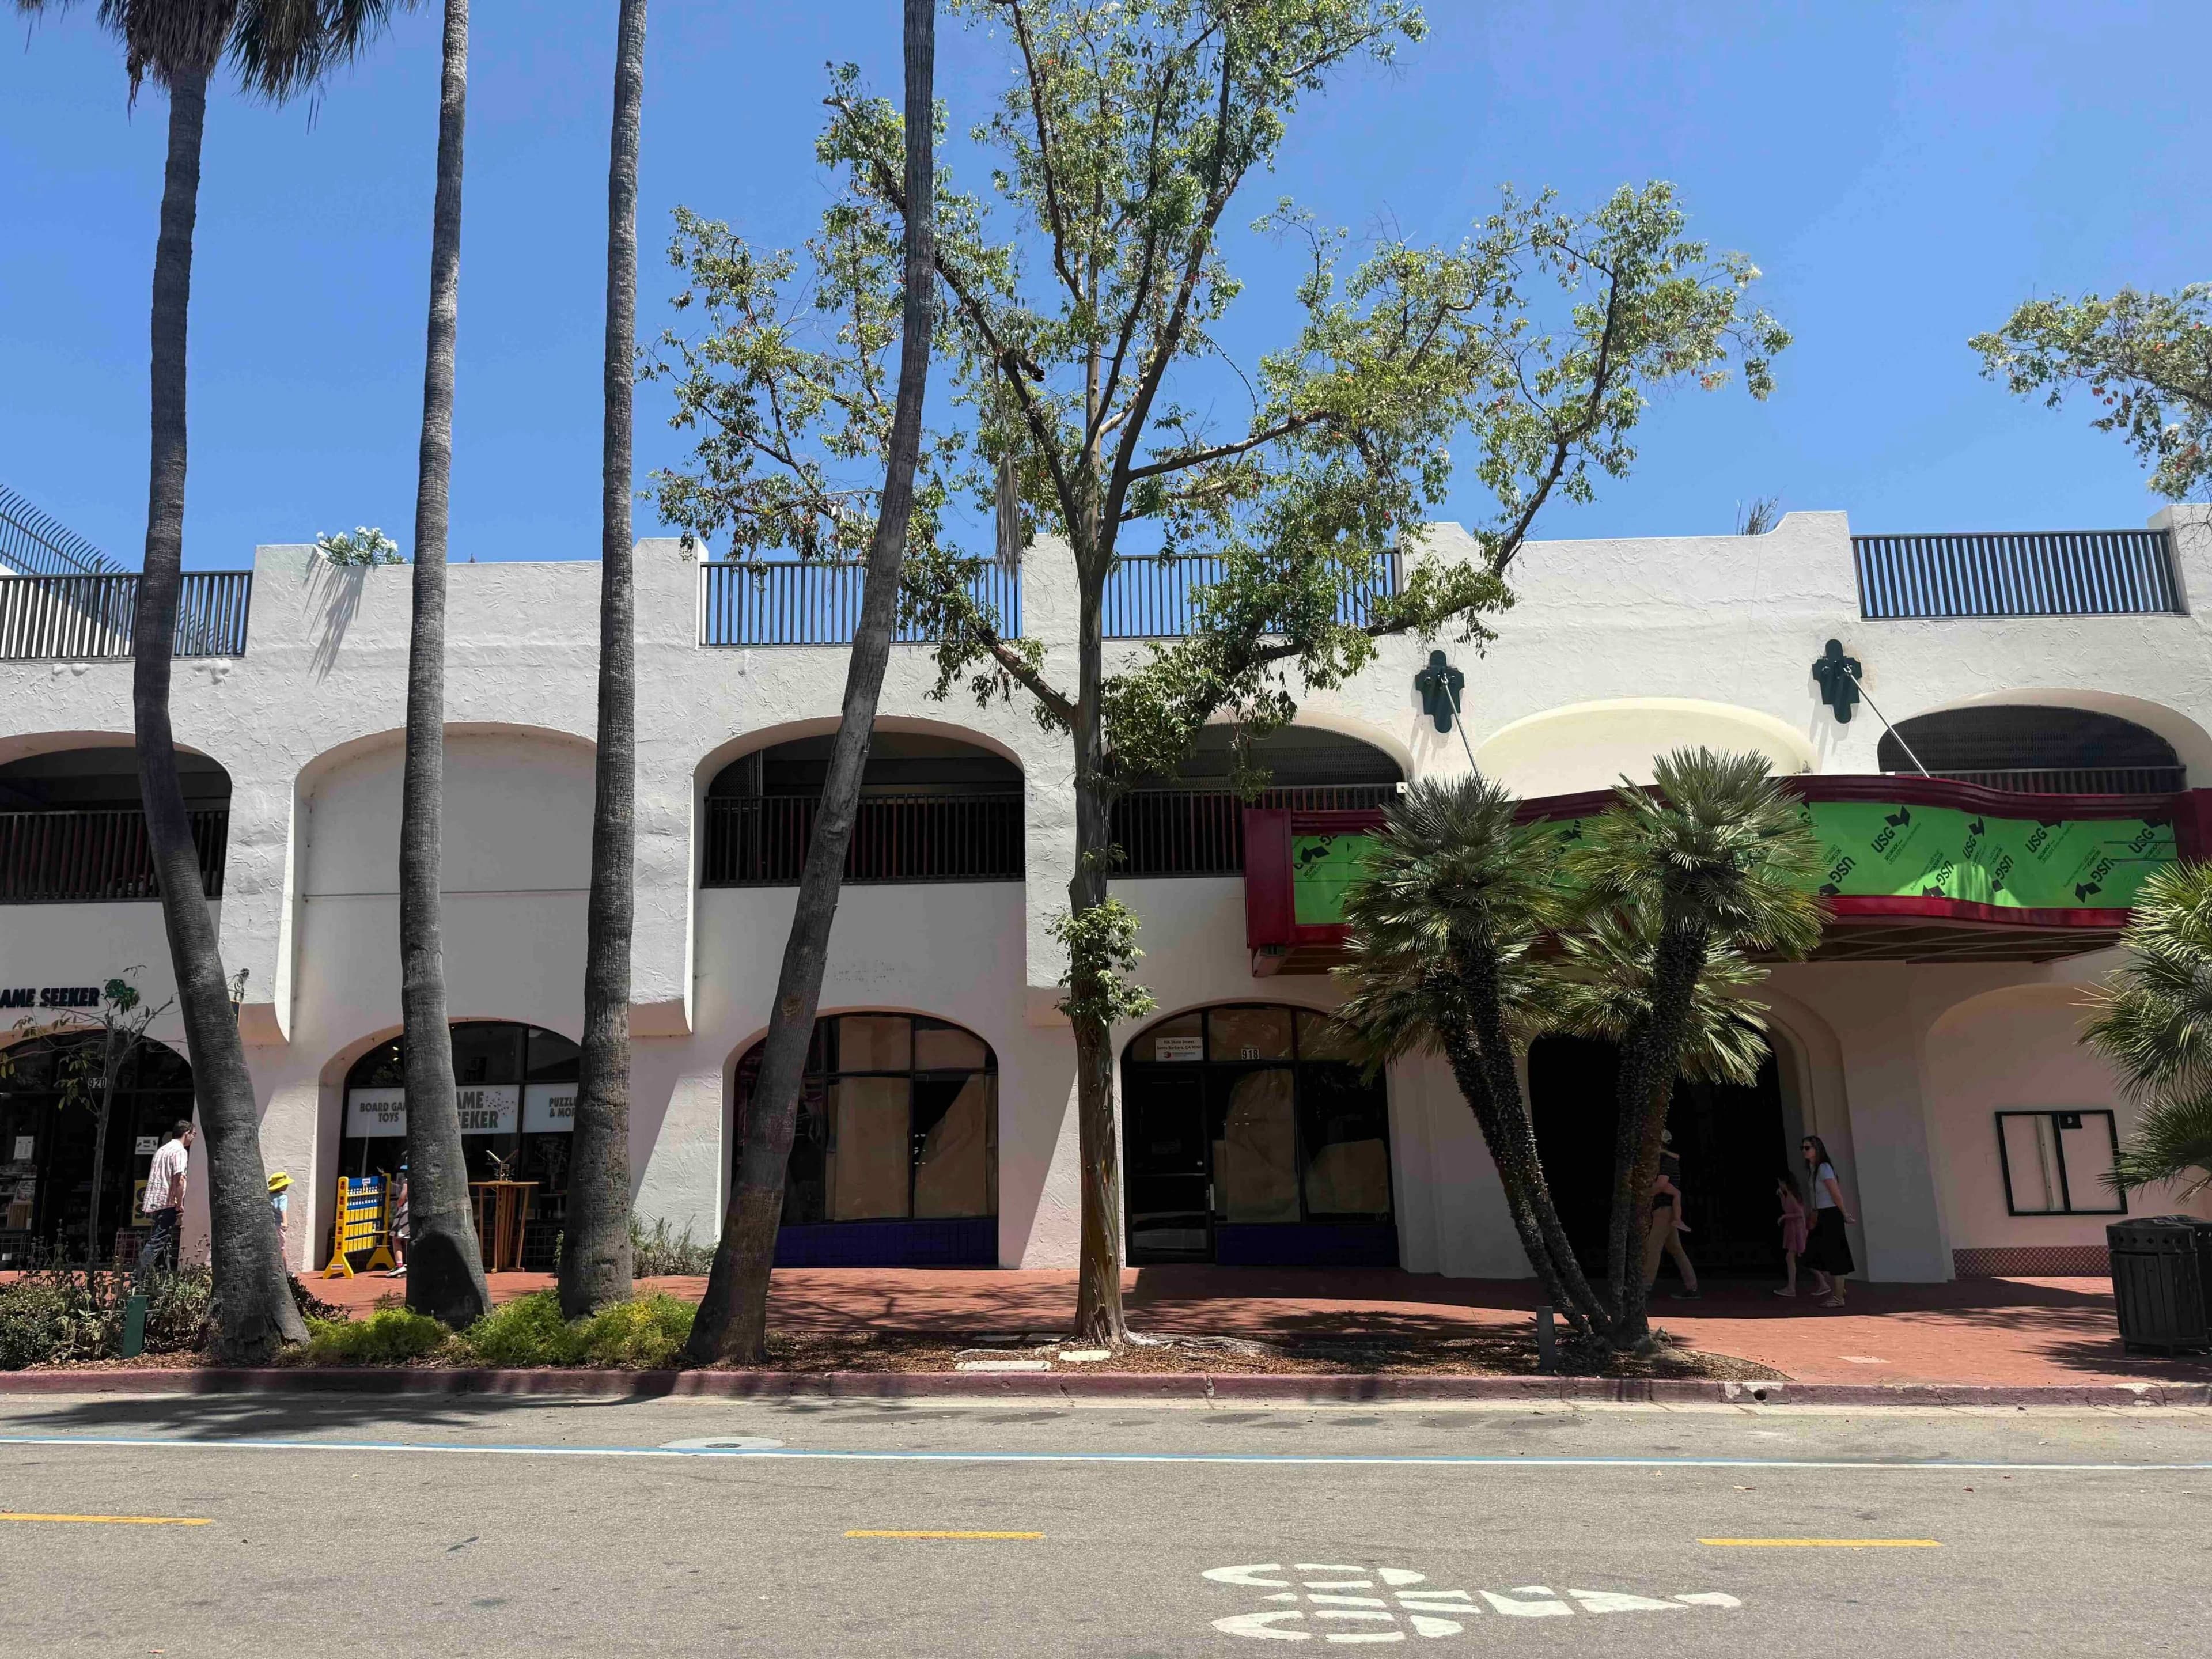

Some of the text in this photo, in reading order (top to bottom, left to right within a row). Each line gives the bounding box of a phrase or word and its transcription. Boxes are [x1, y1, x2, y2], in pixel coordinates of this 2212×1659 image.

[1870, 827, 1895, 853] USG
[1963, 835, 1977, 859] USG
[2024, 827, 2047, 853] USG
[2128, 828, 2155, 854] USG
[1828, 856, 1857, 884] USG
[1935, 860, 1955, 886] USG
[1995, 855, 2014, 880] USG
[2090, 857, 2115, 882] USG
[0, 988, 100, 1007] AME SEEKER
[1242, 1050, 1258, 1059] 918
[89, 1078, 105, 1088] 920
[359, 1101, 405, 1112] BOARD GA
[456, 1091, 484, 1109] AME
[378, 1112, 399, 1123] TOYS
[458, 1111, 498, 1129] EKER
